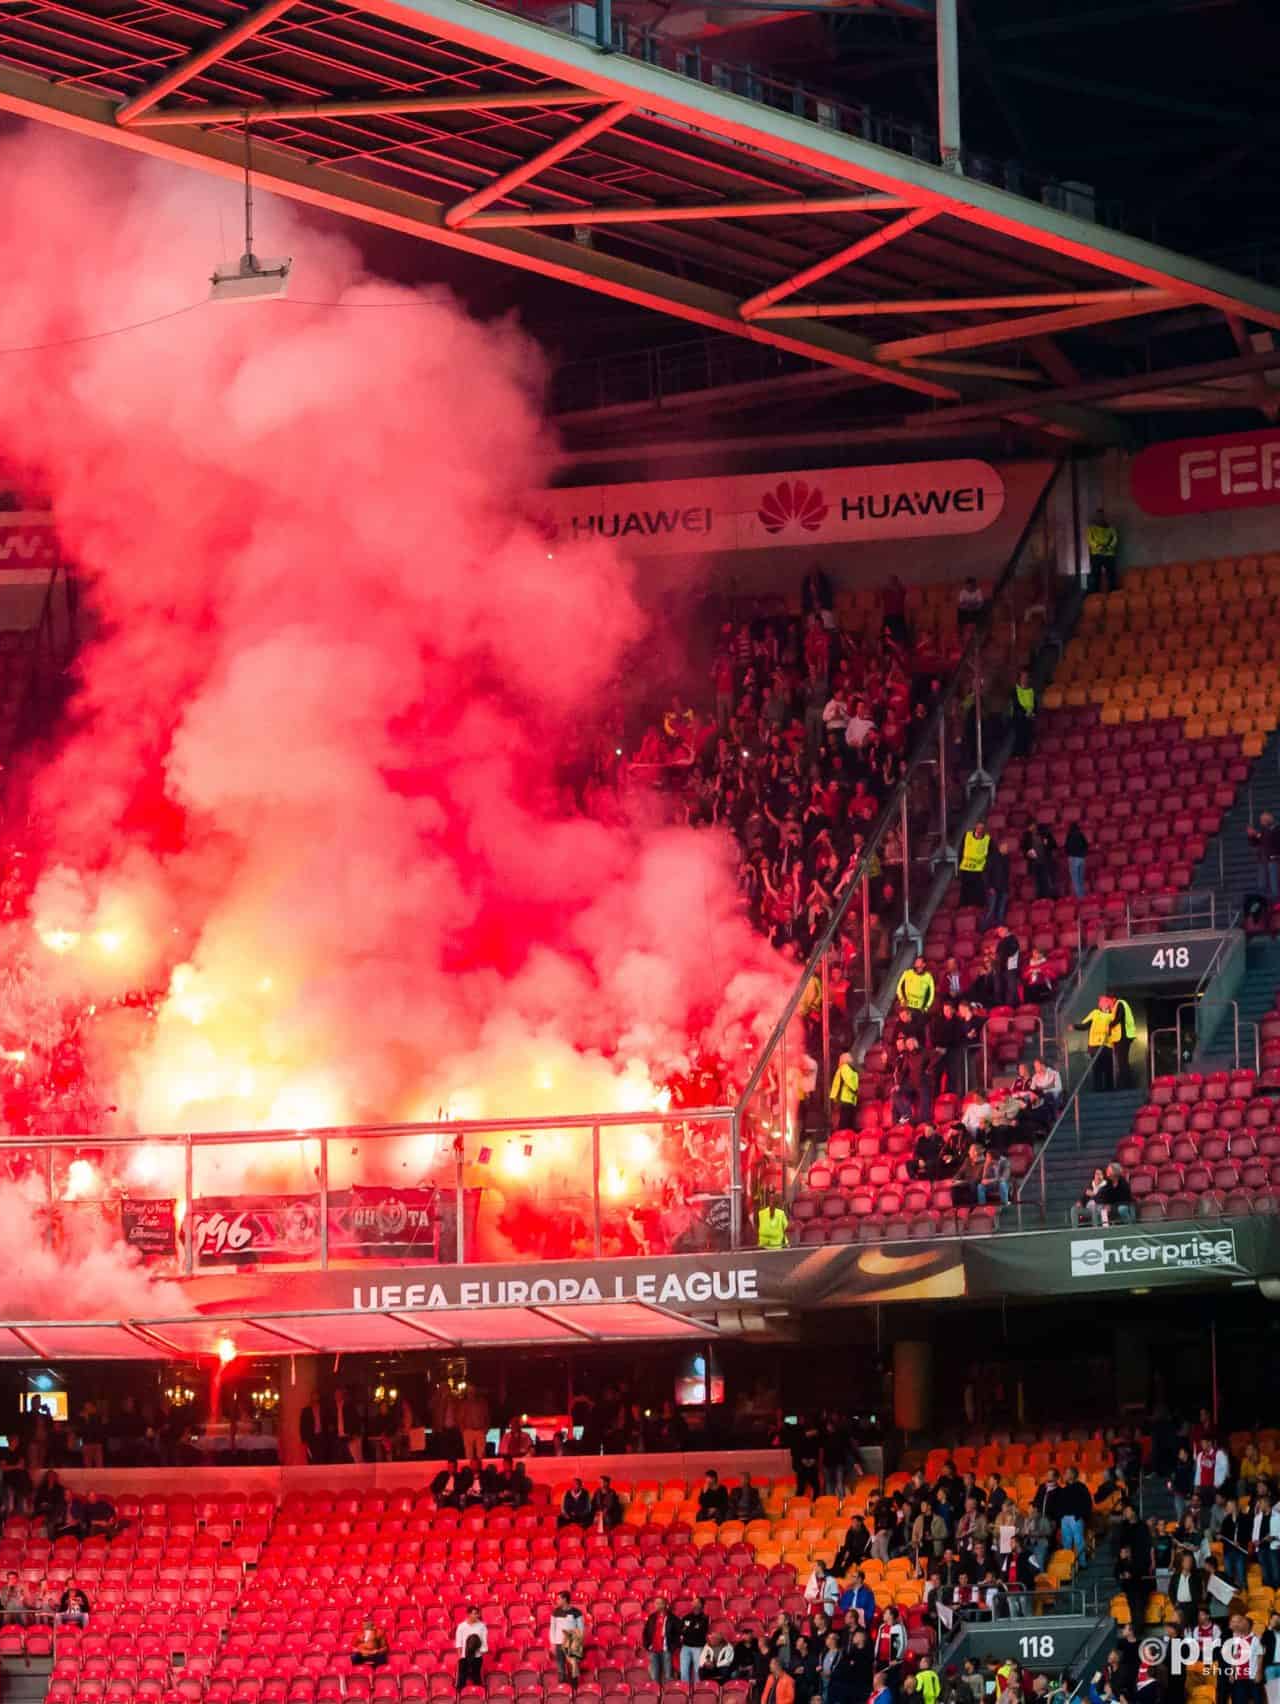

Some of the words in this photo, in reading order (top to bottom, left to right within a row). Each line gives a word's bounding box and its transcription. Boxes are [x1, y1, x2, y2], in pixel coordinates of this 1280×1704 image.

[840, 486, 985, 522] HUAWEI
[571, 506, 714, 540] HUAWEI
[1151, 946, 1190, 969] 418
[1079, 1238, 1233, 1266] enterprise
[352, 1283, 449, 1312] UEFA
[460, 1276, 598, 1305] EUROPA
[614, 1269, 759, 1303] LEAGUE
[1019, 1635, 1055, 1658] 118
